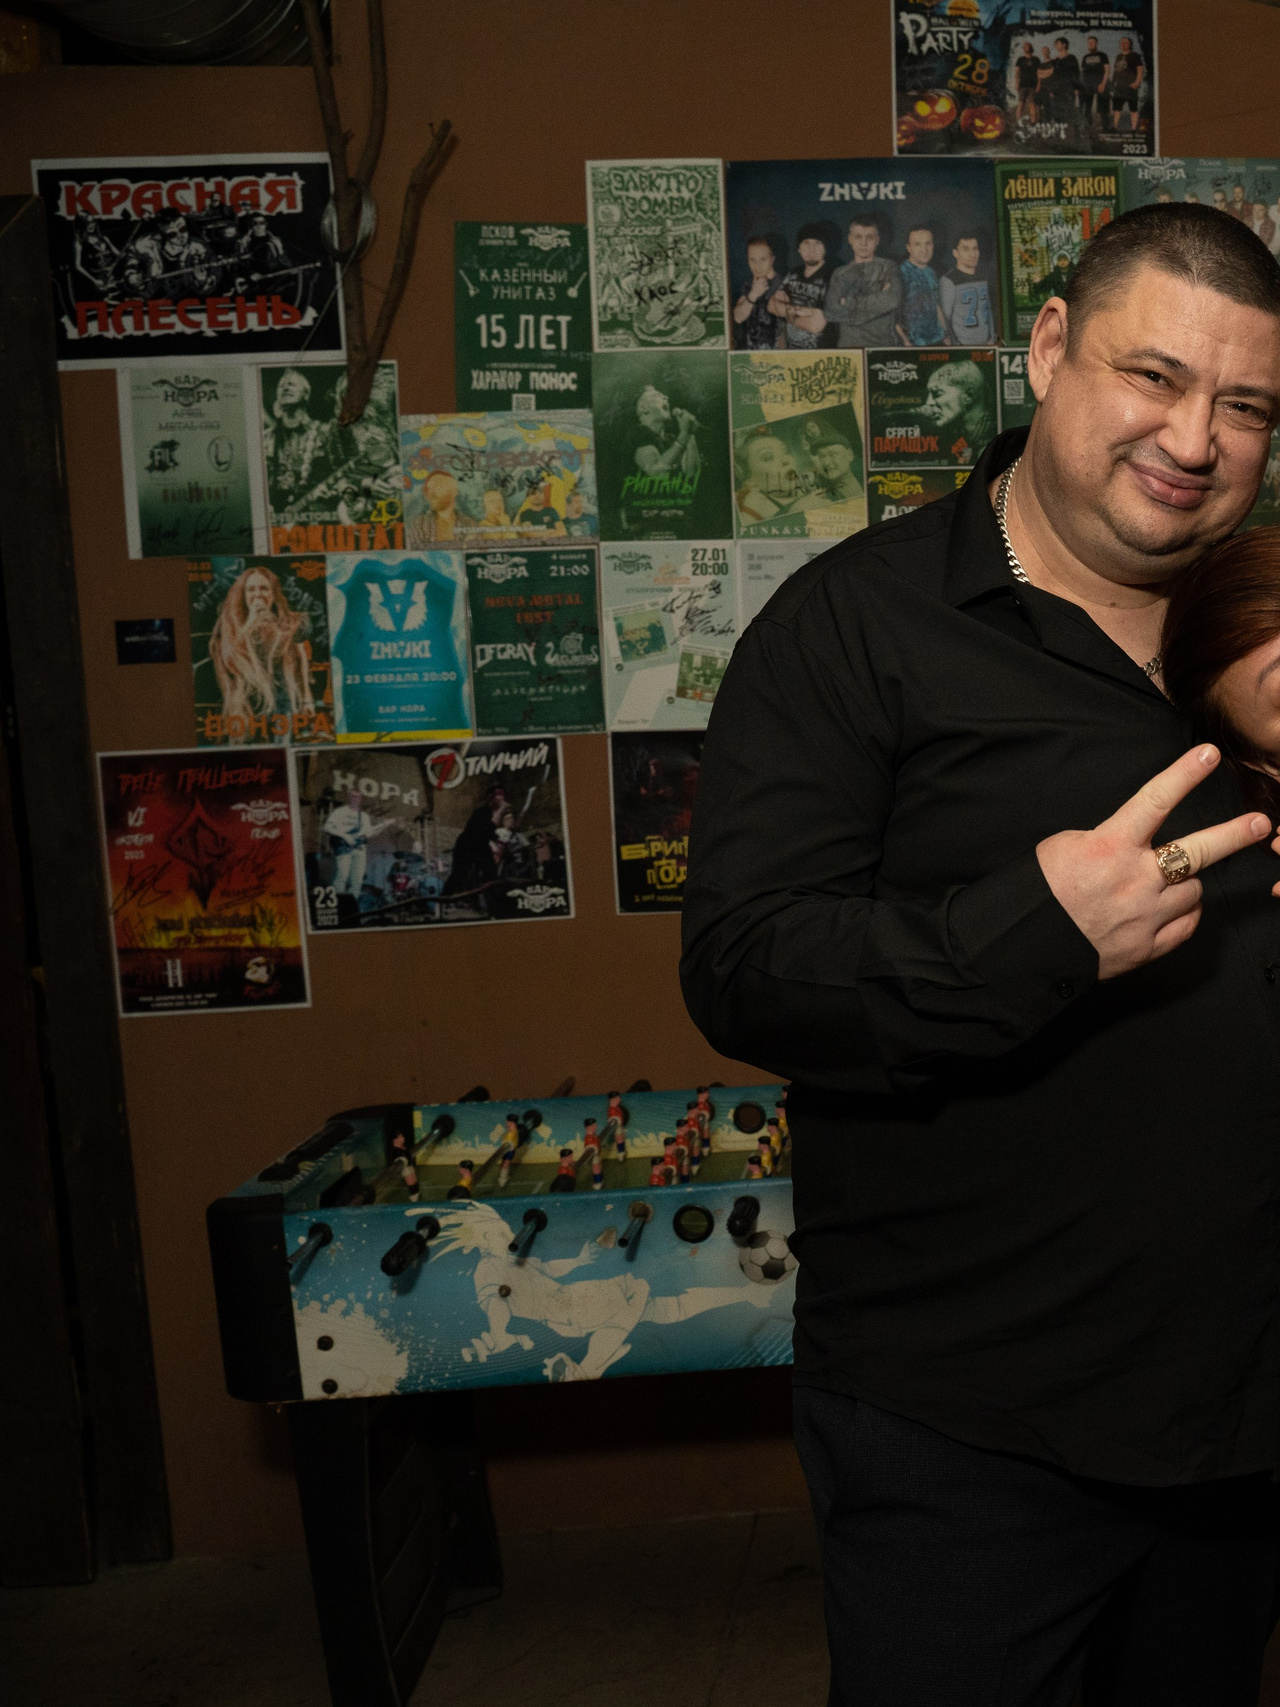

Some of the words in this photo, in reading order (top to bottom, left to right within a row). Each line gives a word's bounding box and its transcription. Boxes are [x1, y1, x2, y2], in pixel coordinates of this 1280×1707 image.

[899, 11, 976, 56] PARTY
[953, 53, 990, 84] 28
[1122, 144, 1143, 154] 2023
[613, 172, 701, 194] ЭЛЕКТРО
[1138, 168, 1186, 183] НОРА
[1004, 174, 1056, 200] ЛЁША
[1061, 176, 1117, 198] ЗАКОН
[65, 178, 299, 218] КРАСНАЯ
[624, 196, 694, 217] ЗОМБИ
[479, 268, 568, 284] КАЗЕННЫЙ
[491, 285, 557, 300] УНИТАЗ
[77, 295, 304, 337] ПЛЕСЕНЬ
[475, 314, 508, 349] 15
[514, 314, 572, 351] ЛЕТ
[886, 361, 907, 370] БАР
[879, 370, 918, 385] НОРА
[165, 390, 219, 407] НОРА
[878, 483, 924, 500] НОРА
[691, 548, 728, 562] 27.01
[477, 566, 529, 584] НОРА
[549, 564, 591, 578] 21:00
[692, 562, 729, 577] 20:00
[346, 674, 362, 685] 23
[363, 672, 420, 684] ФЕВРАЛЯ
[422, 671, 458, 682] 20:00
[431, 752, 456, 789] 7
[332, 763, 421, 807] НОРА
[313, 885, 338, 908] 23
[525, 886, 548, 895] БАР
[517, 894, 566, 913] НОРА
